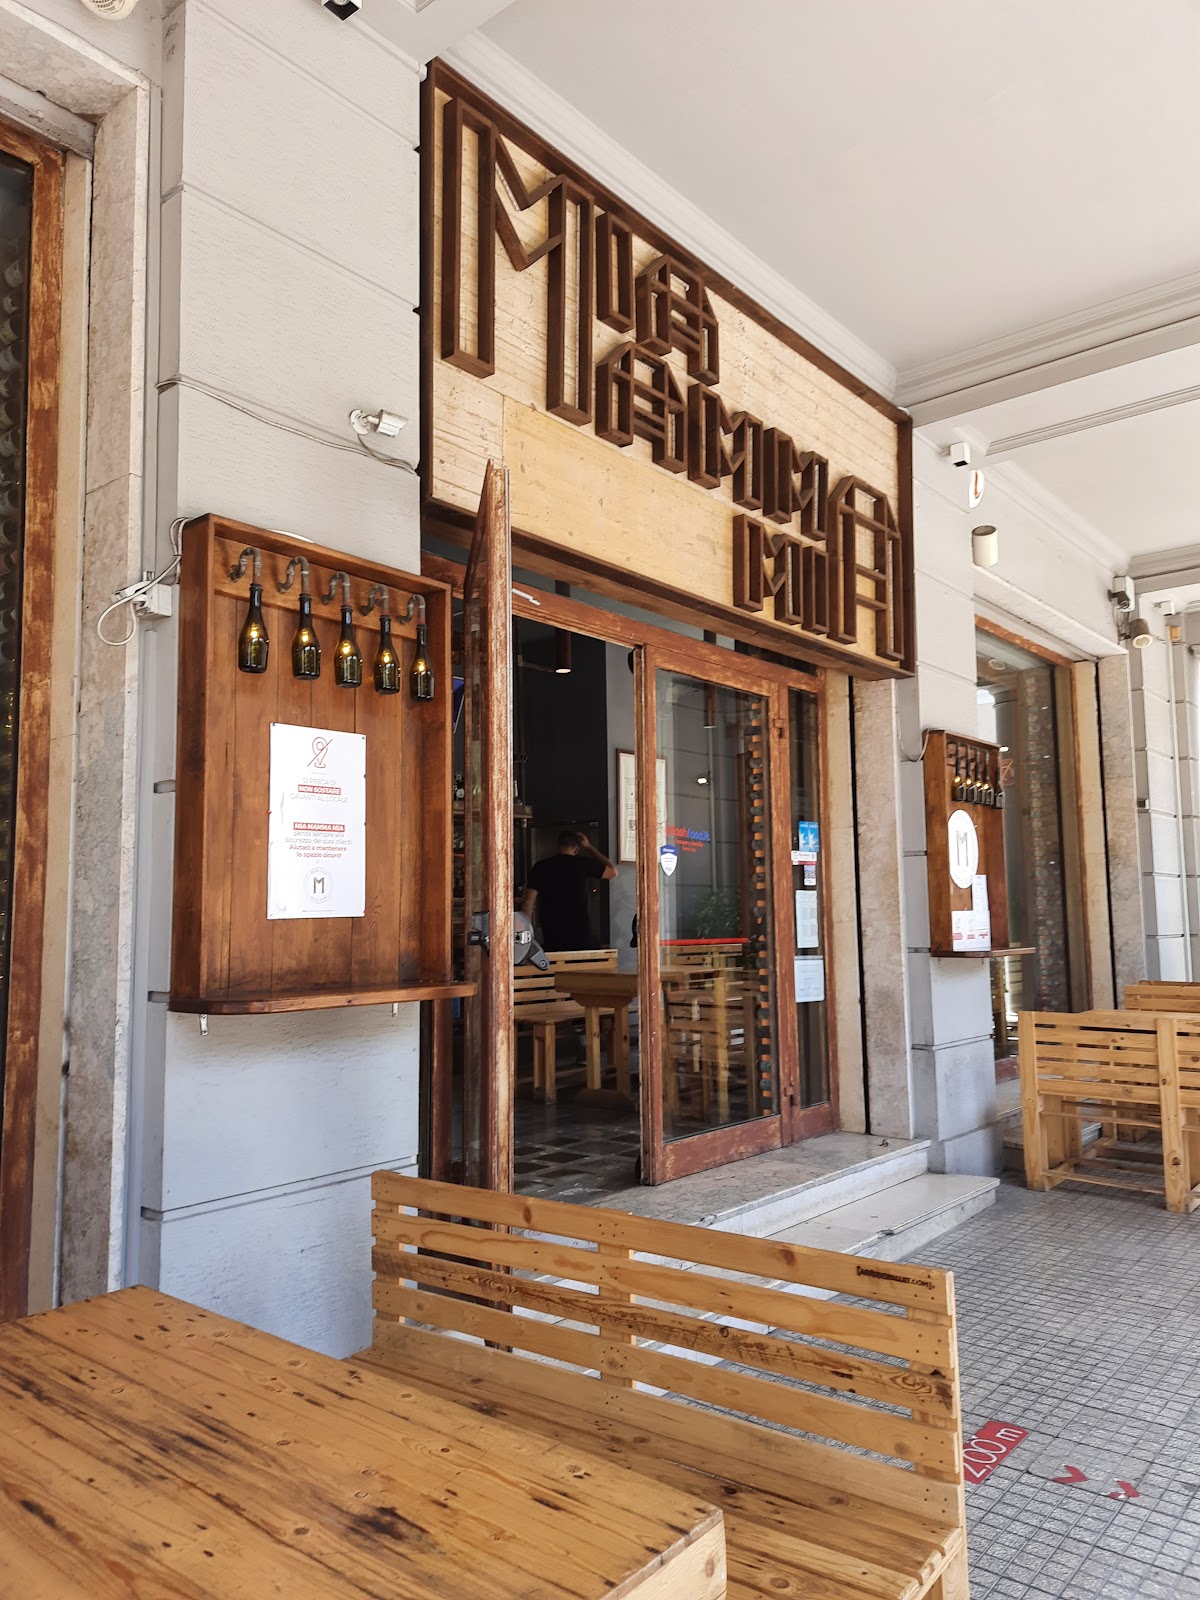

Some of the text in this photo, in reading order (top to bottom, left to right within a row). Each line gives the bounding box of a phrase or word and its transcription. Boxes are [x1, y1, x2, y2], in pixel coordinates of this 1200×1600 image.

[299, 785, 341, 795] NON SOSTARE
[307, 823, 332, 831] MAMMA
[956, 831, 969, 867] M
[313, 876, 326, 894] M
